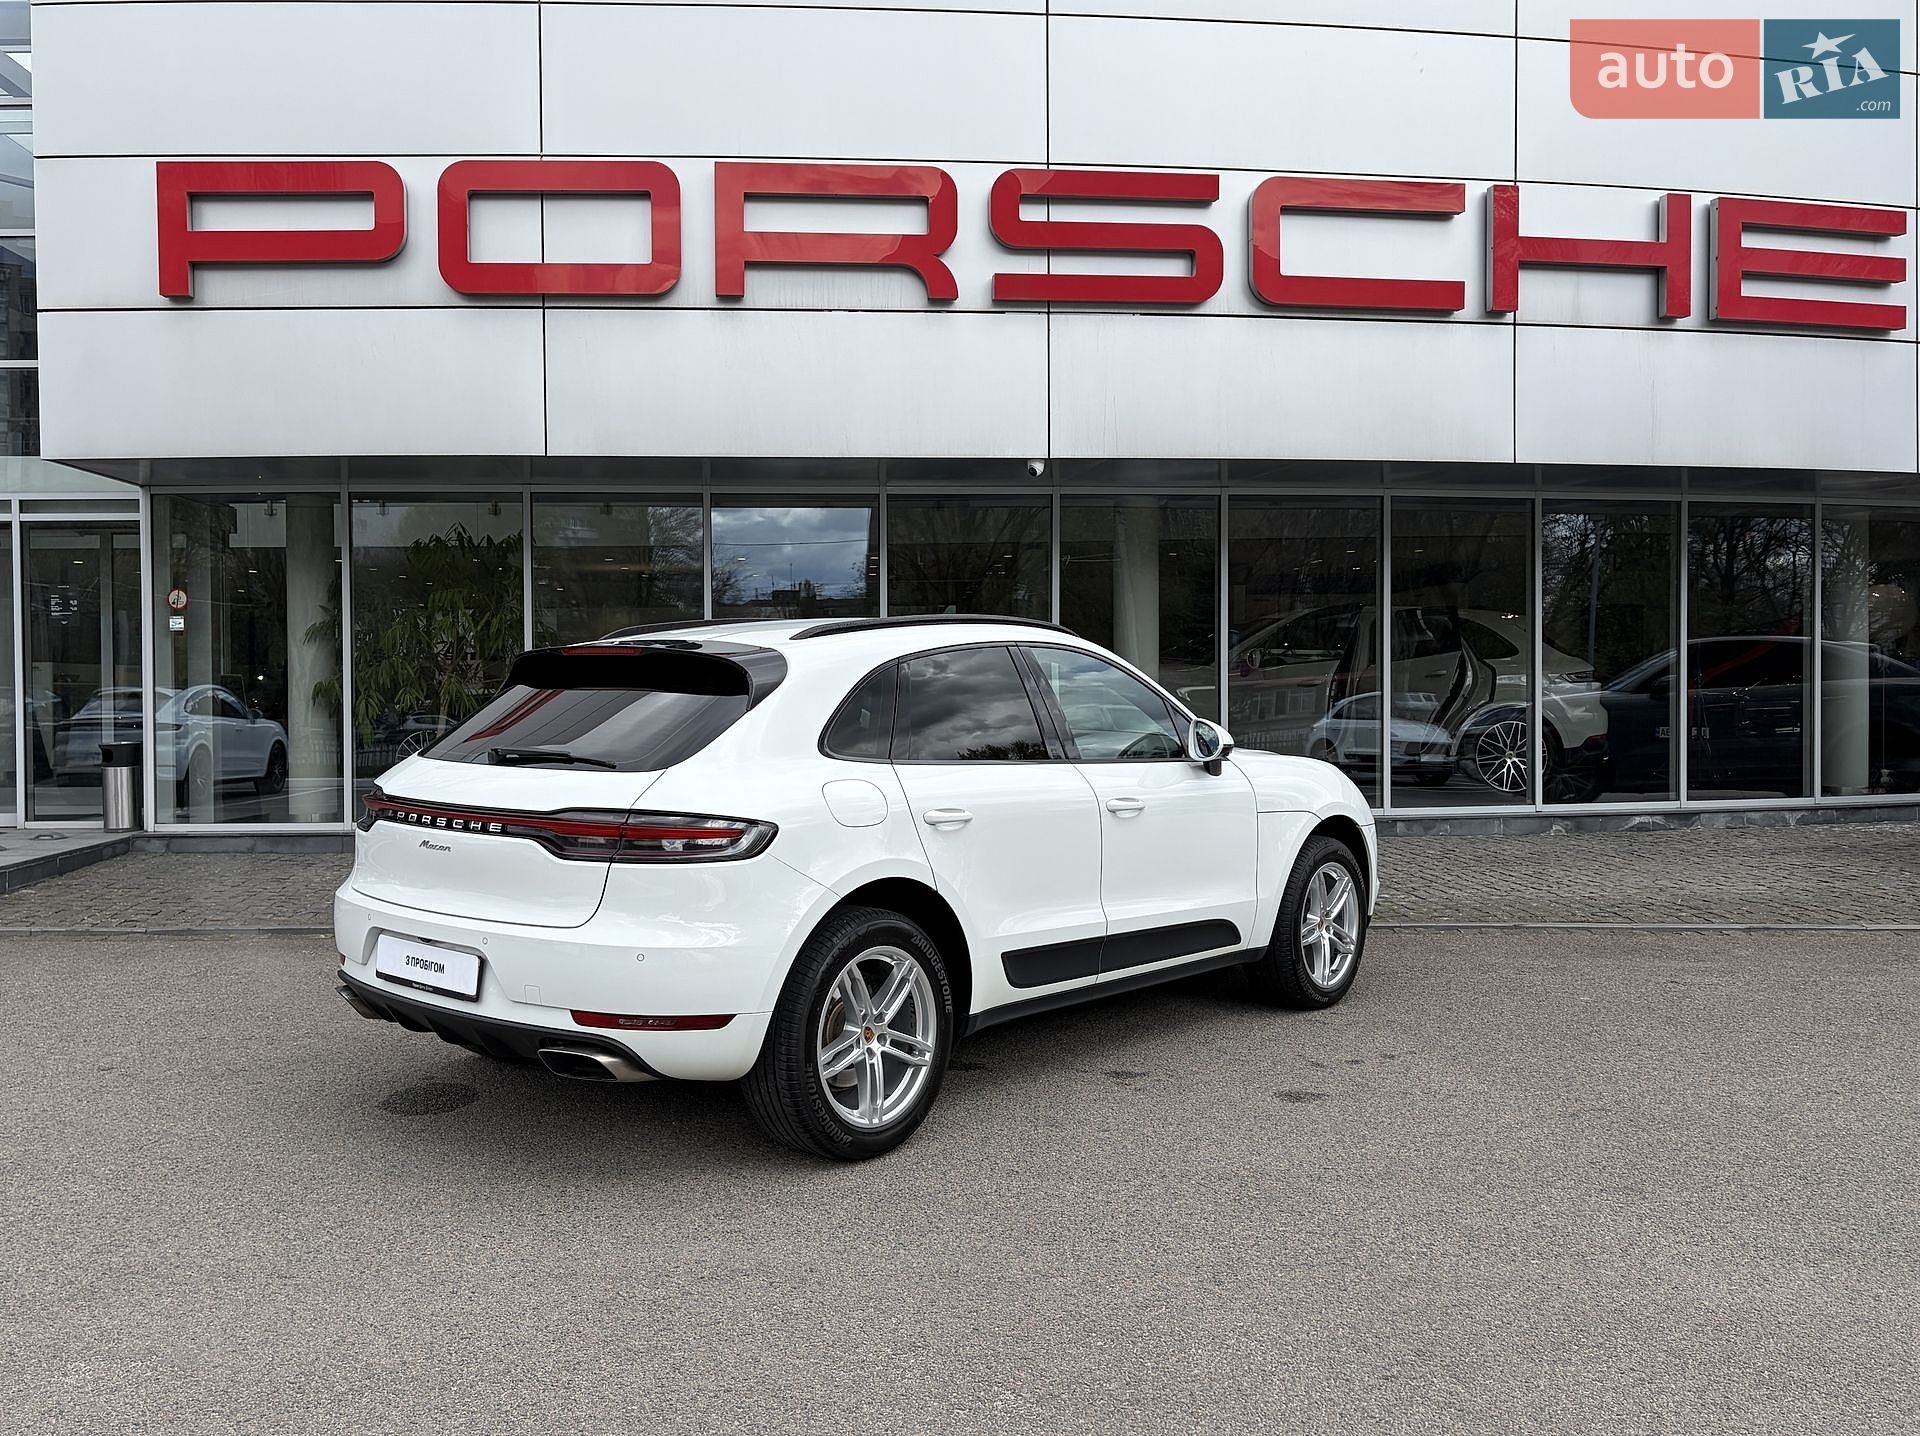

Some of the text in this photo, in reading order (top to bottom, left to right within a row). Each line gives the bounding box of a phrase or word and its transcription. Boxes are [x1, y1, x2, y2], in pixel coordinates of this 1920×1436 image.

[156, 160, 1907, 333] PORSCHE
[397, 811, 502, 833] PORSCHE
[418, 839, 453, 853] Macan
[411, 956, 445, 975] ПРОБІГОМ
